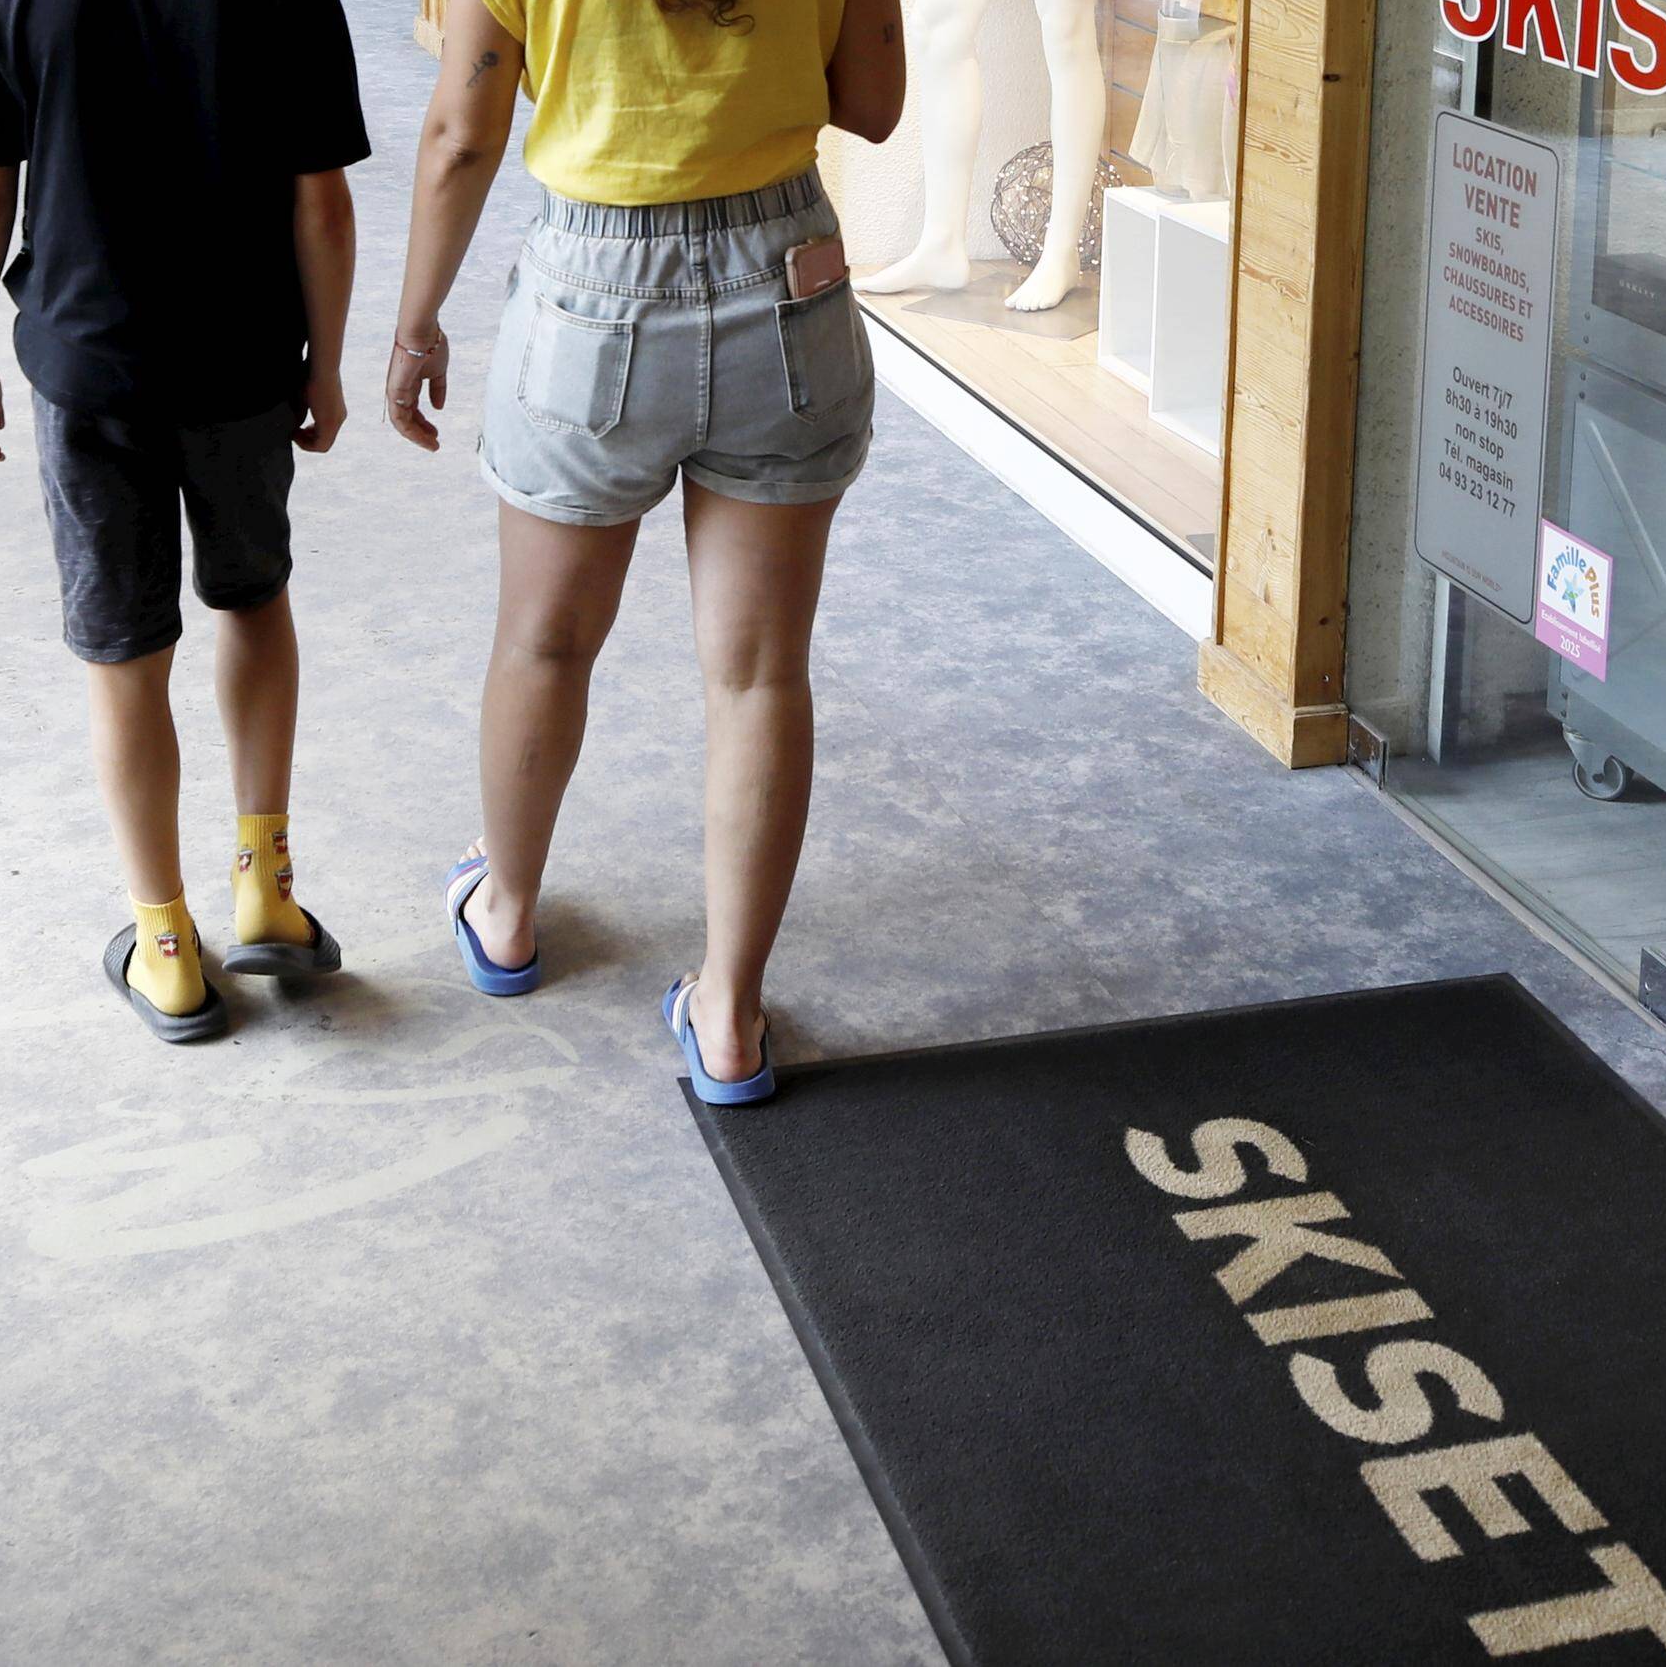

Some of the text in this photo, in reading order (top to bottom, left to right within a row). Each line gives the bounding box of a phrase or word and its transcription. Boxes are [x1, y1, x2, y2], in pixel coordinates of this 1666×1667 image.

[1453, 142, 1537, 197] LOCATION
[1464, 183, 1520, 228] VENTE
[1475, 226, 1504, 255] SKIS,
[1448, 242, 1530, 293] SNOWBOARDS,
[1443, 266, 1533, 319] CHAUSSURES ET
[1448, 294, 1523, 342] ACCESSOIRES
[1453, 366, 1513, 411] Ouvert 7j/7
[1445, 388, 1518, 439] 8h30 à 19h30
[1444, 438, 1514, 492] Tél. magasin
[1455, 422, 1505, 462] non stop
[1439, 462, 1516, 519] 04 93 23 12 77
[1546, 545, 1587, 592] Famille
[1560, 635, 1582, 659] 2025
